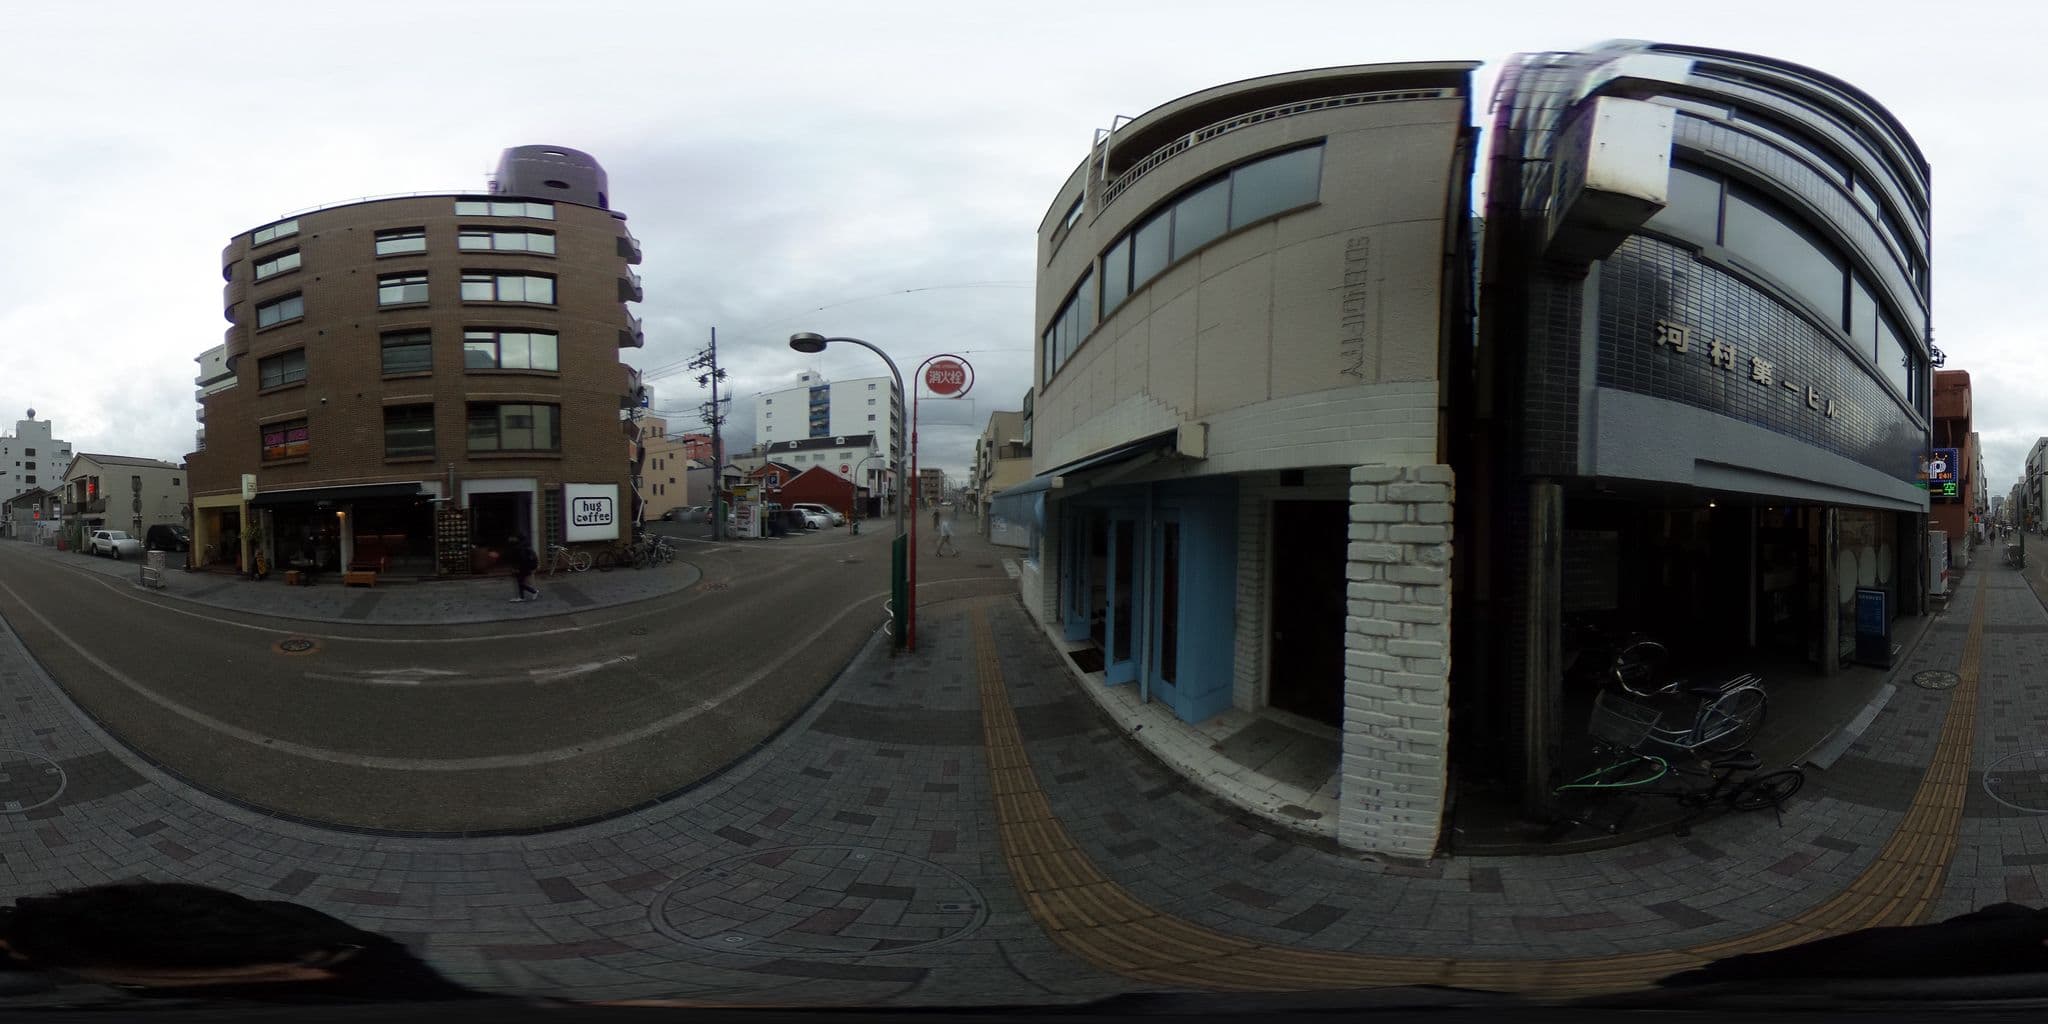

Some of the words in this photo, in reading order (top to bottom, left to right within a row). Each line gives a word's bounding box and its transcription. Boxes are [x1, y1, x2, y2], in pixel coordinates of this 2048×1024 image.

[1656, 319, 1839, 418] 河村第一ビル
[929, 369, 963, 384] 消火栓
[583, 500, 602, 512] hug
[576, 511, 610, 522] coffee
